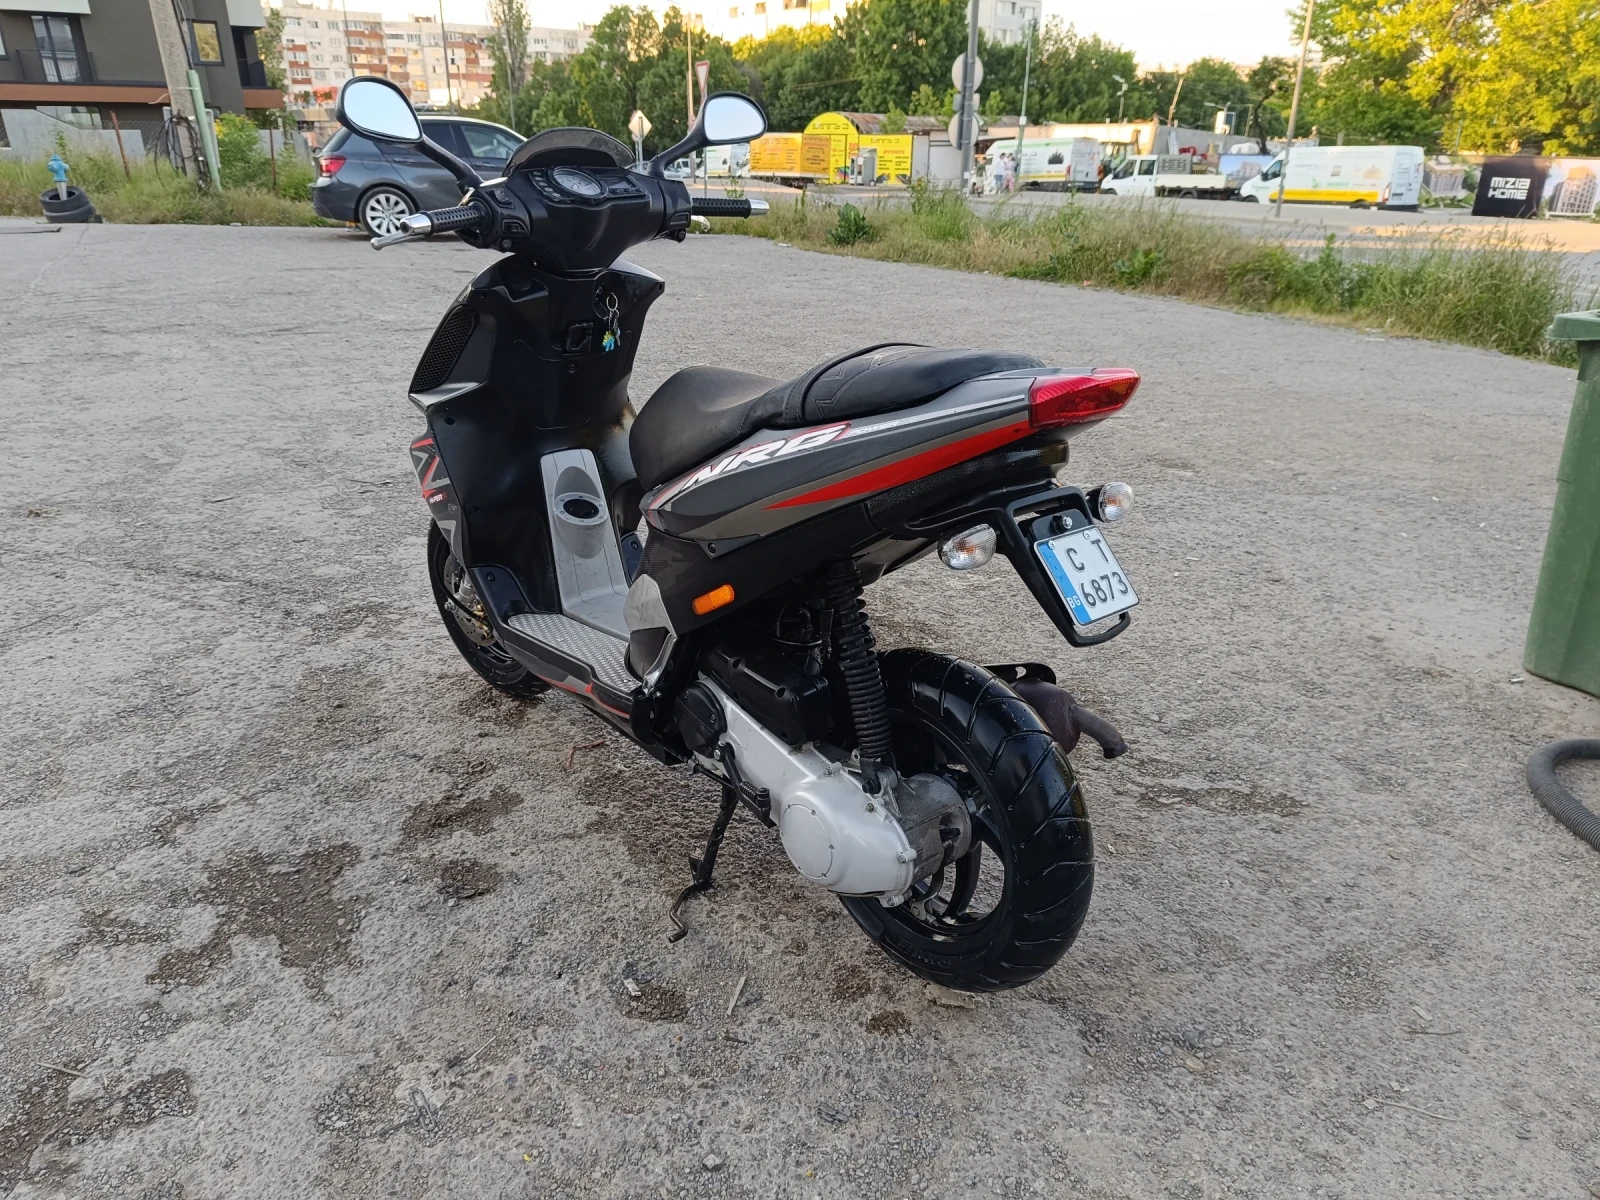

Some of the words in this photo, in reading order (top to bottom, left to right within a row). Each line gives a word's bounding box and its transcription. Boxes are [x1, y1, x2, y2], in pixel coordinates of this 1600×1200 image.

[1488, 188, 1528, 200] HOME
[1490, 176, 1531, 189] MIZIA
[681, 423, 849, 492] NRG
[848, 420, 900, 437] POWER
[1066, 547, 1086, 572] C
[1091, 538, 1109, 563] T
[1081, 571, 1129, 607] 6873
[1066, 595, 1081, 609] BG
